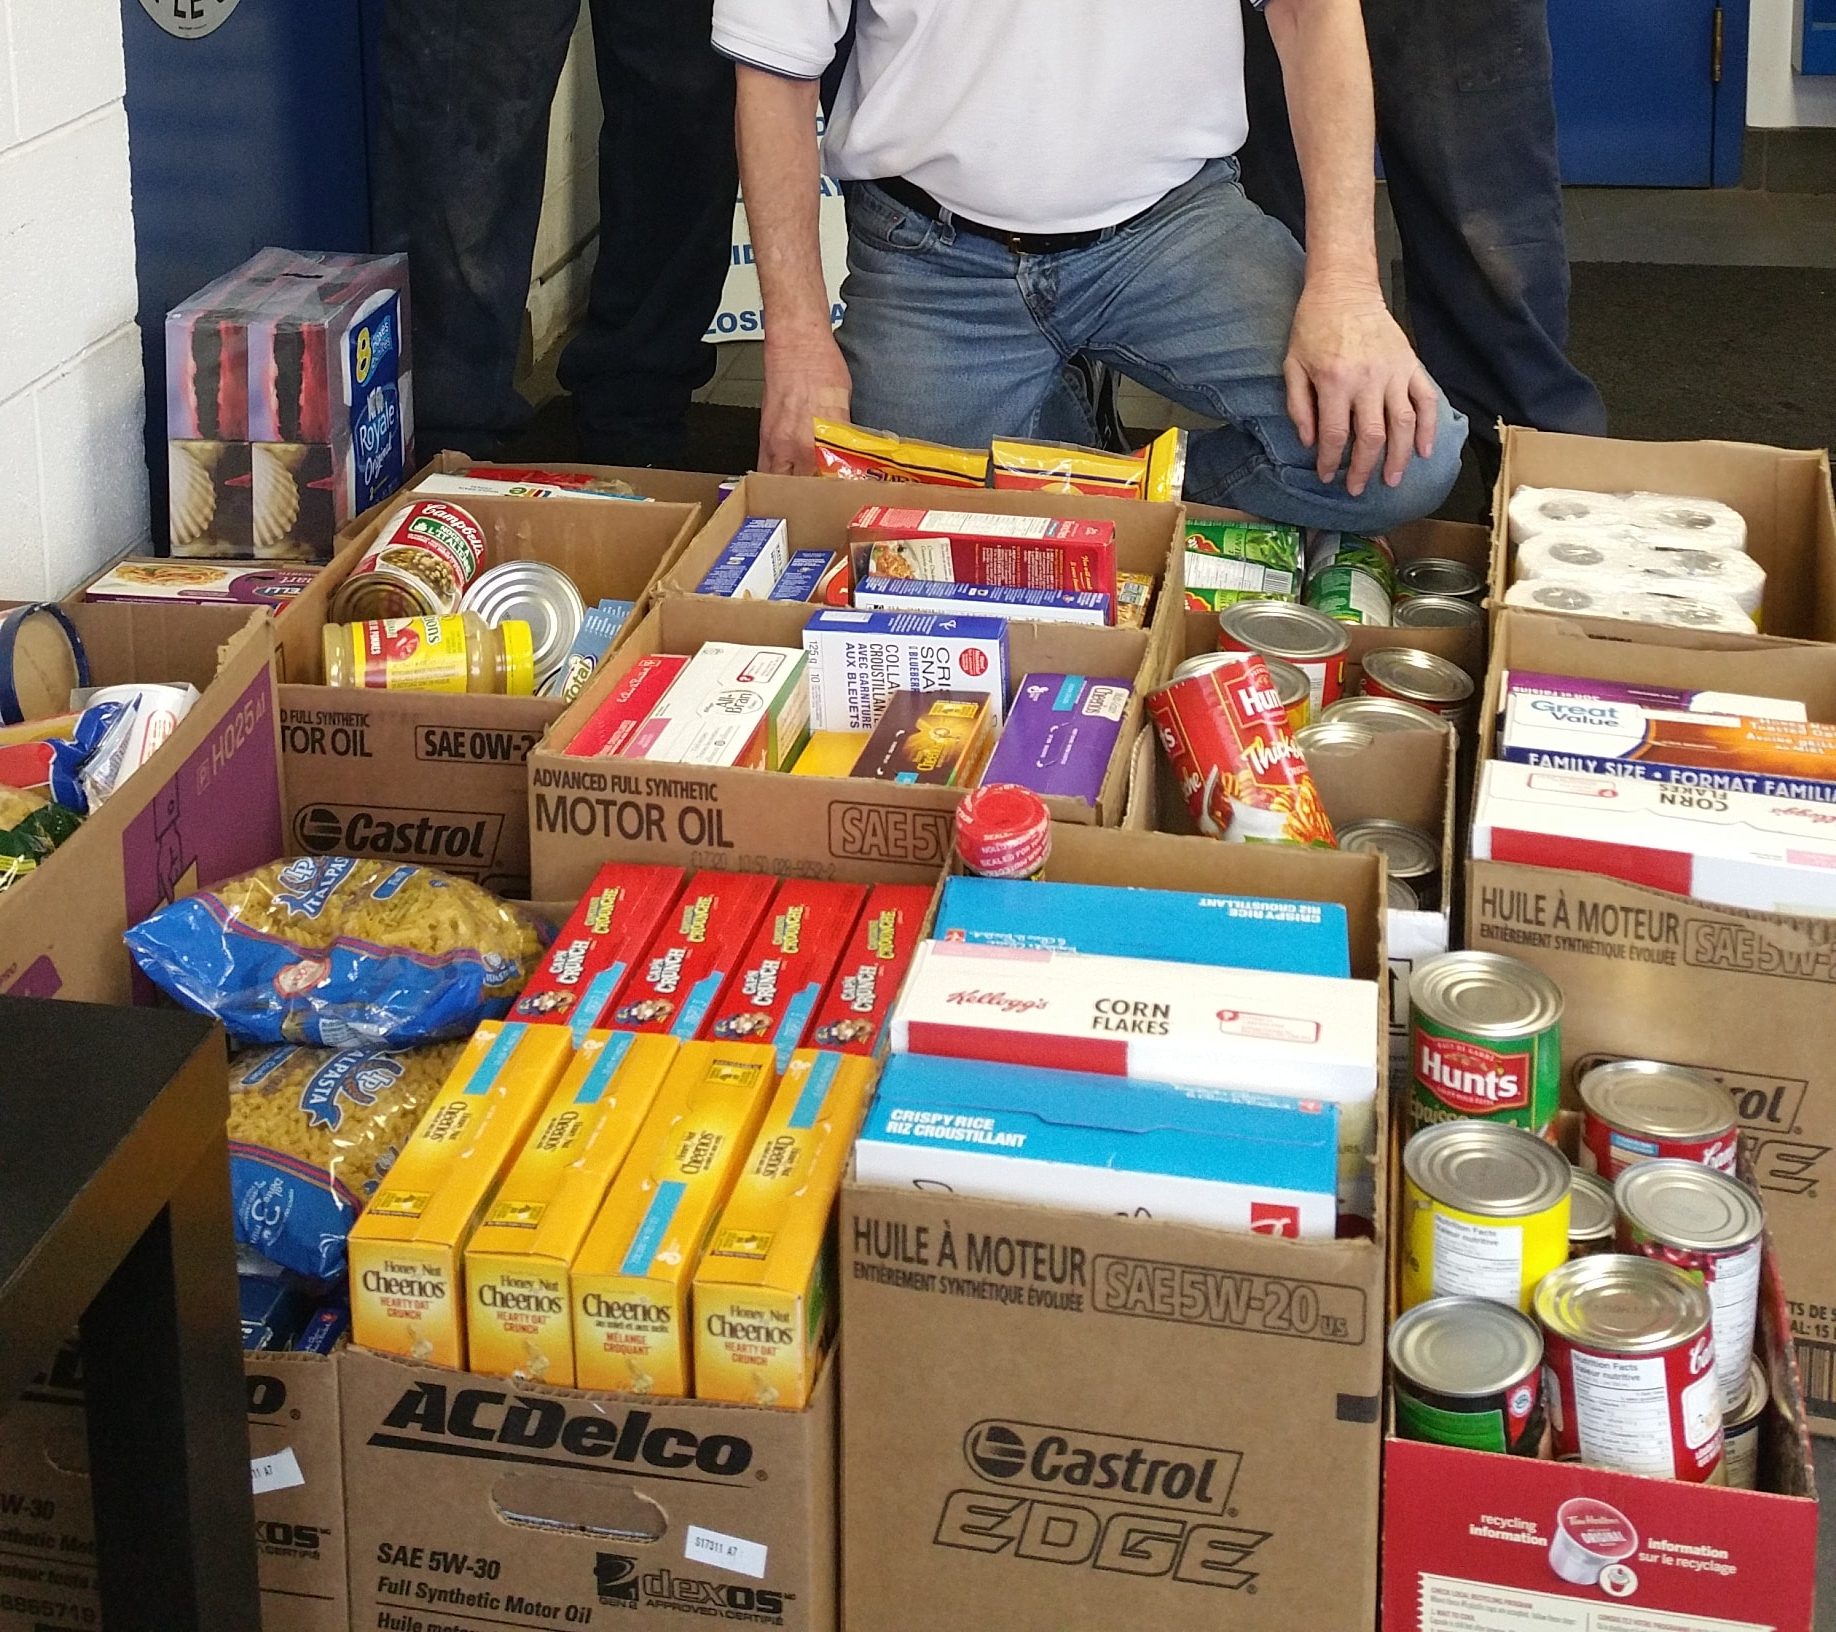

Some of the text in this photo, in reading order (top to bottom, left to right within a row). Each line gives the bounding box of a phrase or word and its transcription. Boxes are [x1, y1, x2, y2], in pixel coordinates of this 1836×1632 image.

[356, 326, 372, 384] 8
[359, 403, 395, 457] Royale
[421, 501, 482, 558] Campbell's
[846, 642, 860, 729] AUX BLEUETS
[858, 643, 872, 729] AVEC GARNITURE
[289, 709, 371, 729] FULL SYNTHETIC
[1530, 699, 1621, 720] Great
[1550, 711, 1621, 729] Value
[331, 729, 373, 759] OIL
[424, 730, 466, 759] SAE
[533, 769, 719, 802] ADVANCED FULL SYNTHETIC
[1528, 752, 1758, 796] FAMILY SIZE FORMAT
[1660, 793, 1729, 812] CORN
[344, 811, 487, 859] Castrol
[535, 794, 735, 849] MOTOR OIL
[841, 807, 907, 857] SAE
[1197, 898, 1297, 914] CROUSTILLANT
[1228, 908, 1322, 924] CRISPY RICE
[1481, 885, 1680, 946] HUILE À MOTEUR
[1480, 923, 1678, 967] ENTIÈREMENT SYNTHÉTIQUE ÉVOLUÉE
[1695, 924, 1755, 969] SAE
[557, 938, 592, 984] CRUNCH
[654, 946, 688, 993] CRUNCH
[751, 958, 782, 1006] CRUNCH
[852, 964, 878, 1012] CRUNCH
[946, 989, 1050, 1013] Kellogg's
[1094, 998, 1171, 1020] CORN
[1092, 1015, 1170, 1037] FLAKES
[885, 1120, 1027, 1148] RIZ CROUSTILLANT
[890, 1110, 996, 1131] CRISPY RICE
[853, 1215, 1087, 1287] HUILE À MOTEUR
[384, 1260, 442, 1277] Honey Nut
[500, 1273, 560, 1292] Honey Nut
[362, 1270, 446, 1300] Cheerios
[478, 1284, 562, 1314] Cheerios
[853, 1259, 1085, 1313] ENTIÈREMENT SYNTHÉTIQUE ÉVOLUÉE
[1107, 1260, 1320, 1334] SAE 5W-20
[380, 1297, 431, 1311] HEARTY OAT
[386, 1308, 422, 1321] CRUNCH
[496, 1311, 547, 1325] HEARTY OAT
[582, 1292, 672, 1323] Cheerios
[730, 1304, 790, 1323] Honey Nut
[1809, 1304, 1828, 1321] DE
[504, 1322, 539, 1335] CRUNCH
[707, 1314, 794, 1345] Cheerios
[1814, 1324, 1832, 1339] 15
[603, 1342, 650, 1357] CROQUANT
[724, 1342, 778, 1357] HEARTY OAT
[731, 1352, 768, 1366] CRUNCH
[1602, 1370, 1641, 1382] nutritive
[1613, 1360, 1639, 1372] Facts
[383, 1380, 754, 1477] ACDelco
[1030, 1434, 1215, 1504] Castrol
[1469, 1523, 1549, 1548] information
[1480, 1513, 1538, 1535] recycling
[727, 1546, 739, 1558] A7
[933, 1488, 1274, 1590] EDGE
[1648, 1537, 1730, 1561] information
[376, 1541, 501, 1581] SAE 5W-30
[1638, 1551, 1738, 1577] sur le recyclage
[377, 1575, 593, 1625] Full Synthetic Motor Oil
[642, 1569, 785, 1615] dexos
[377, 1611, 423, 1632] Huile
